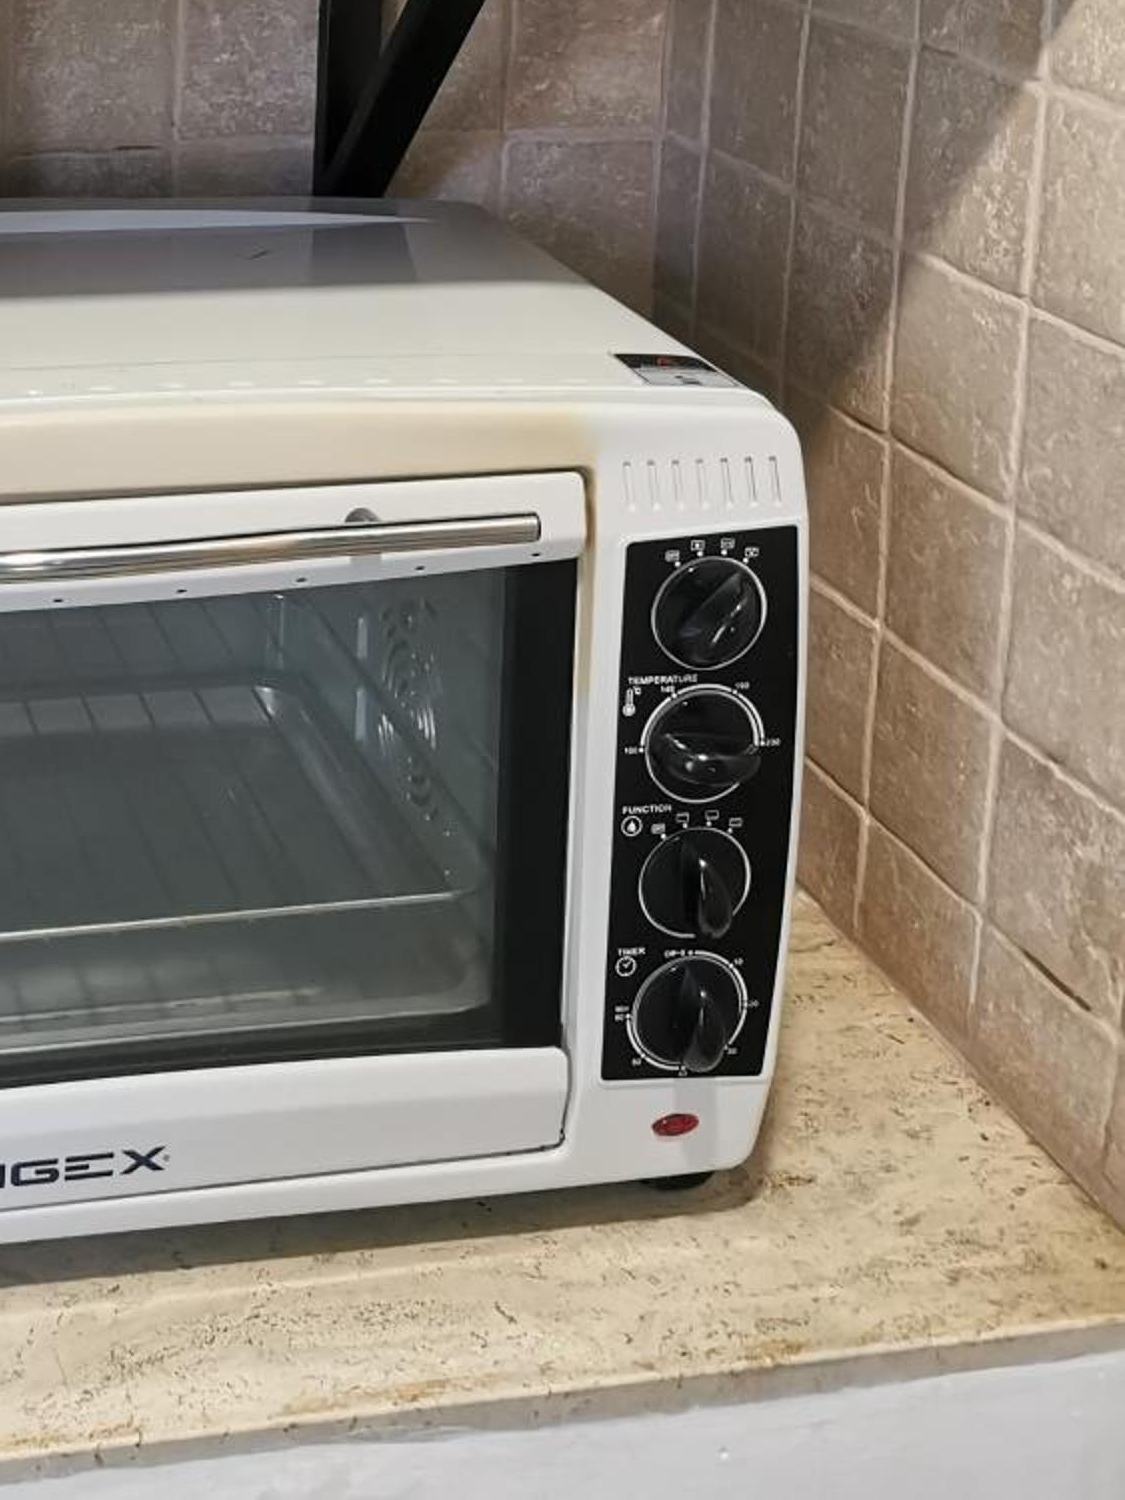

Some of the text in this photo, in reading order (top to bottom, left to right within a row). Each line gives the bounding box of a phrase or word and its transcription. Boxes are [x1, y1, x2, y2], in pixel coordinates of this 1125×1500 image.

[628, 674, 698, 685] TEMPERATURE
[622, 803, 672, 815] FUNCTION
[618, 947, 646, 956] TIMER
